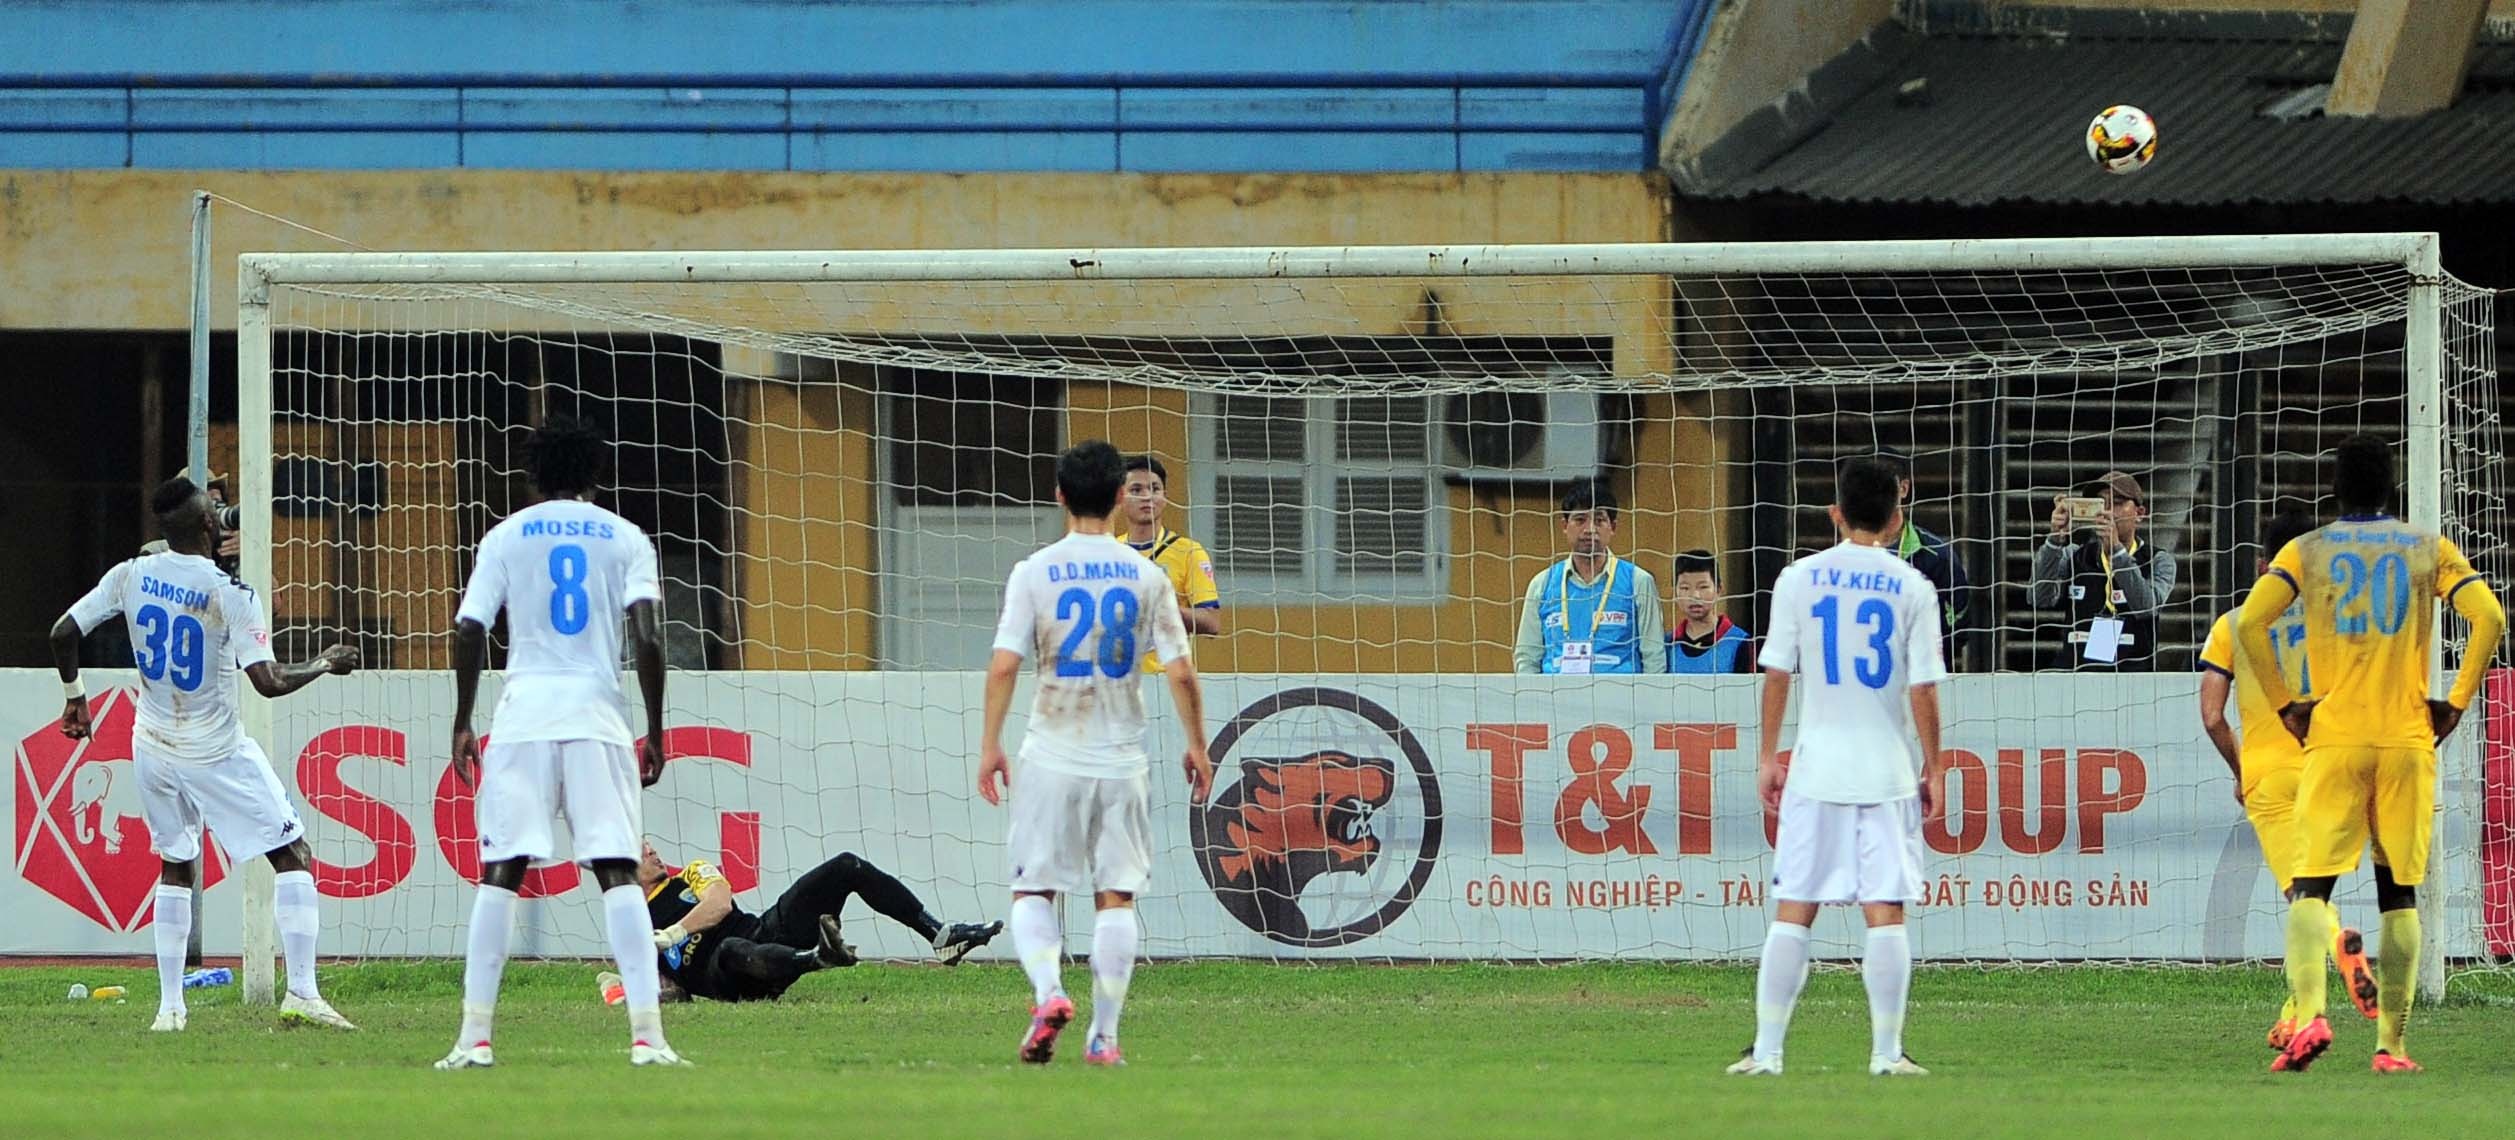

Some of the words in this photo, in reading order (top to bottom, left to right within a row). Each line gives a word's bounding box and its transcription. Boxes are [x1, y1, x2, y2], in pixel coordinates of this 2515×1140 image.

[522, 519, 614, 540] MOSES
[141, 576, 210, 611] SAMSON
[548, 544, 589, 636] 8
[1809, 567, 1903, 595] T.V.KIÊN
[2329, 551, 2411, 635] 20
[136, 604, 204, 692] 39
[1056, 586, 1139, 679] 28
[1811, 594, 1895, 690] 13
[1466, 722, 1737, 856] T&T
[1763, 748, 2148, 856] OUP
[1466, 874, 1552, 907] CÔNG
[1566, 874, 1683, 912] NGHIỆP
[1916, 873, 1971, 907] BẤT
[1984, 874, 2073, 912] ĐỘNG
[2087, 872, 2149, 907] SẢN
